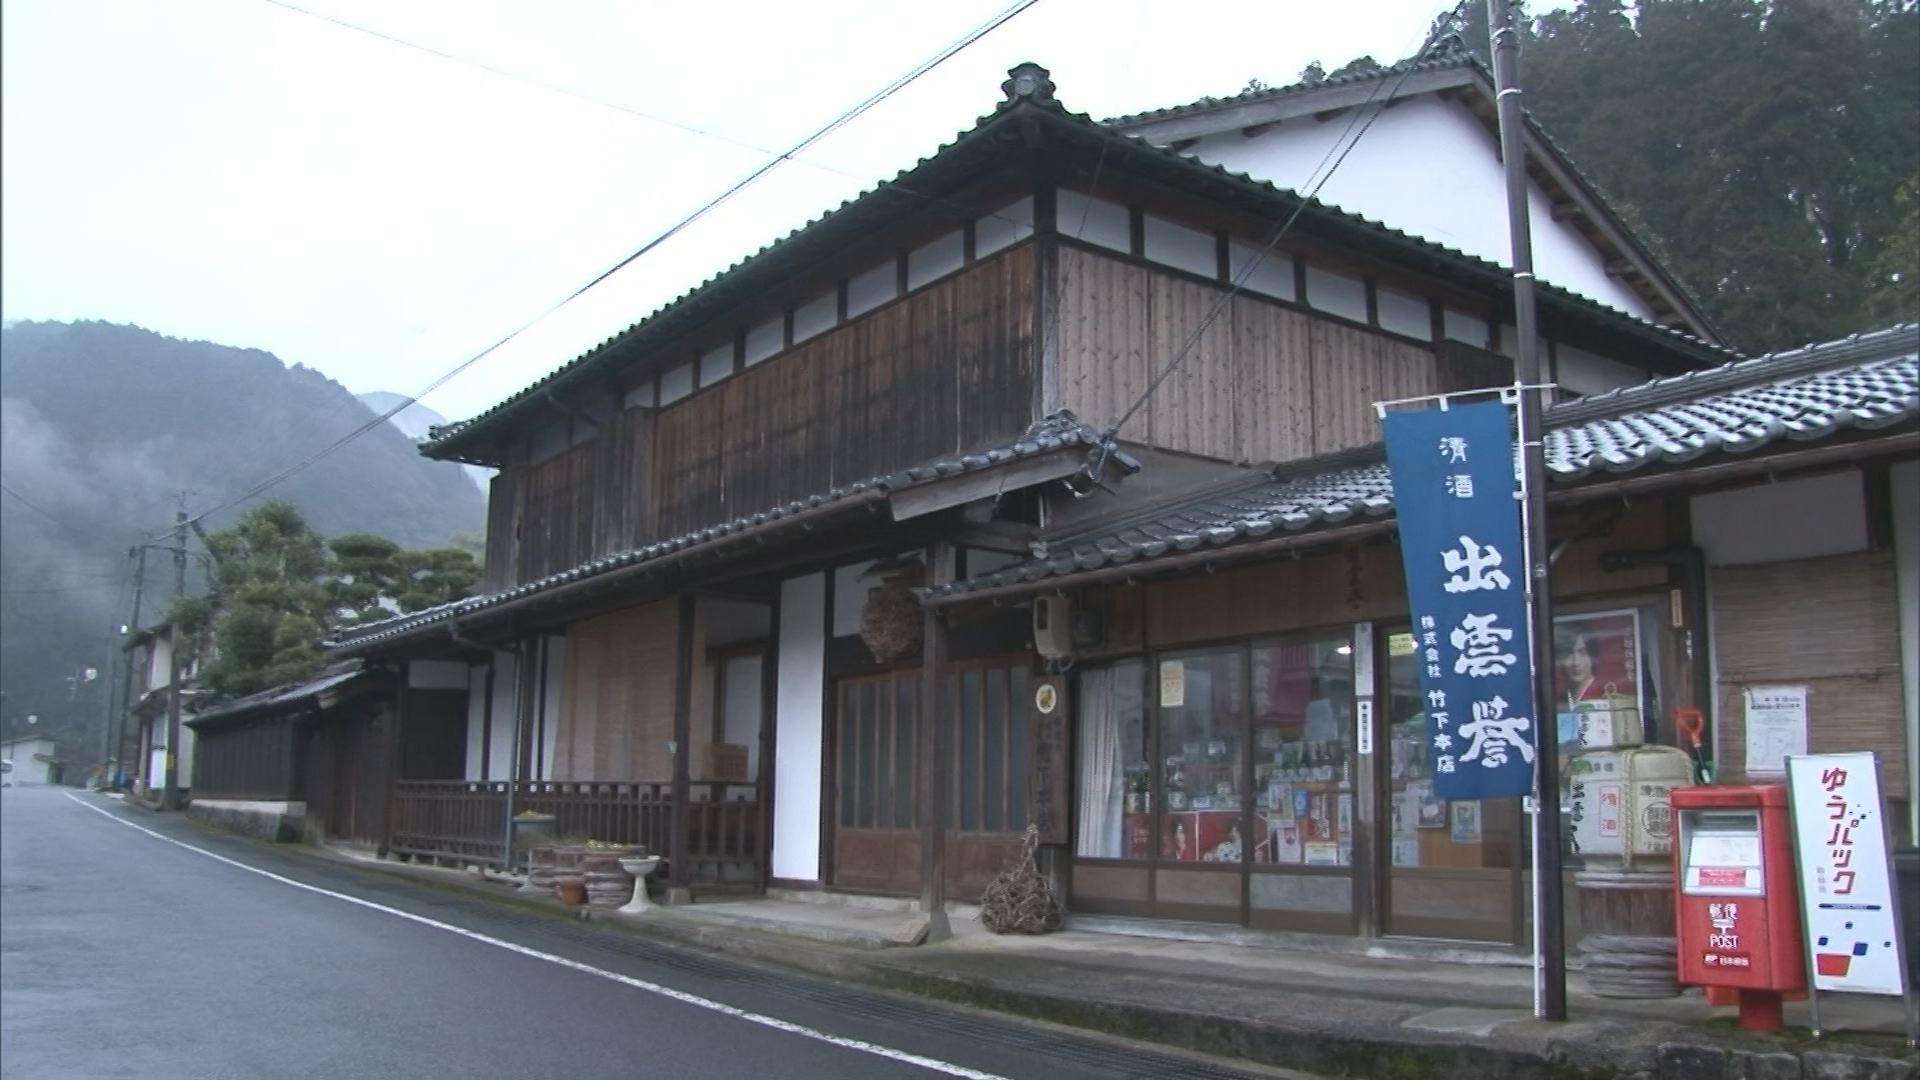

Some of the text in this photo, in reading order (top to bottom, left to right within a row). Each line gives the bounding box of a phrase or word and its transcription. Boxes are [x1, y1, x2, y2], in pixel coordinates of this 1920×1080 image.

[1439, 437, 1474, 498] 清酒
[1421, 615, 1455, 773] 株式会社 竹下本店
[1821, 768, 1859, 895] ゆうパック
[1709, 903, 1737, 920] 郵便
[1709, 934, 1738, 949] POST
